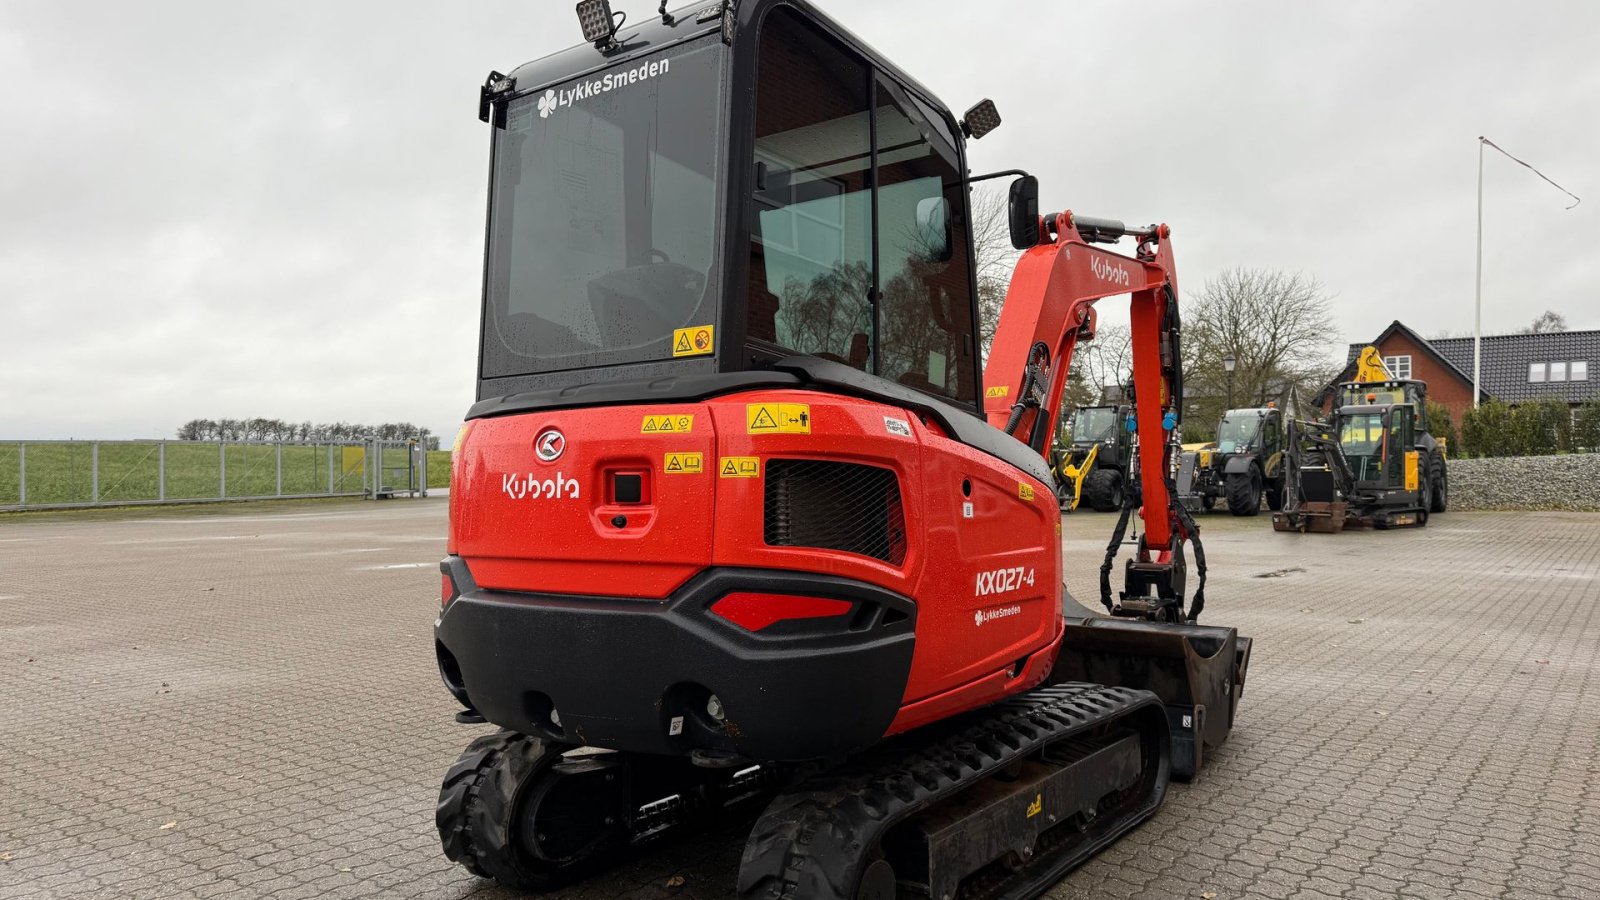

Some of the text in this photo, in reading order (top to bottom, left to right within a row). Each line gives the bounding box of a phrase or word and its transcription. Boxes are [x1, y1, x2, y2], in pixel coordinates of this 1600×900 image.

[558, 58, 670, 108] LykkeSmeden
[1090, 254, 1130, 287] Kubota
[502, 472, 580, 499] Kubota
[975, 566, 1035, 597] KX027-4
[983, 605, 1021, 623] LykkeSmeden
